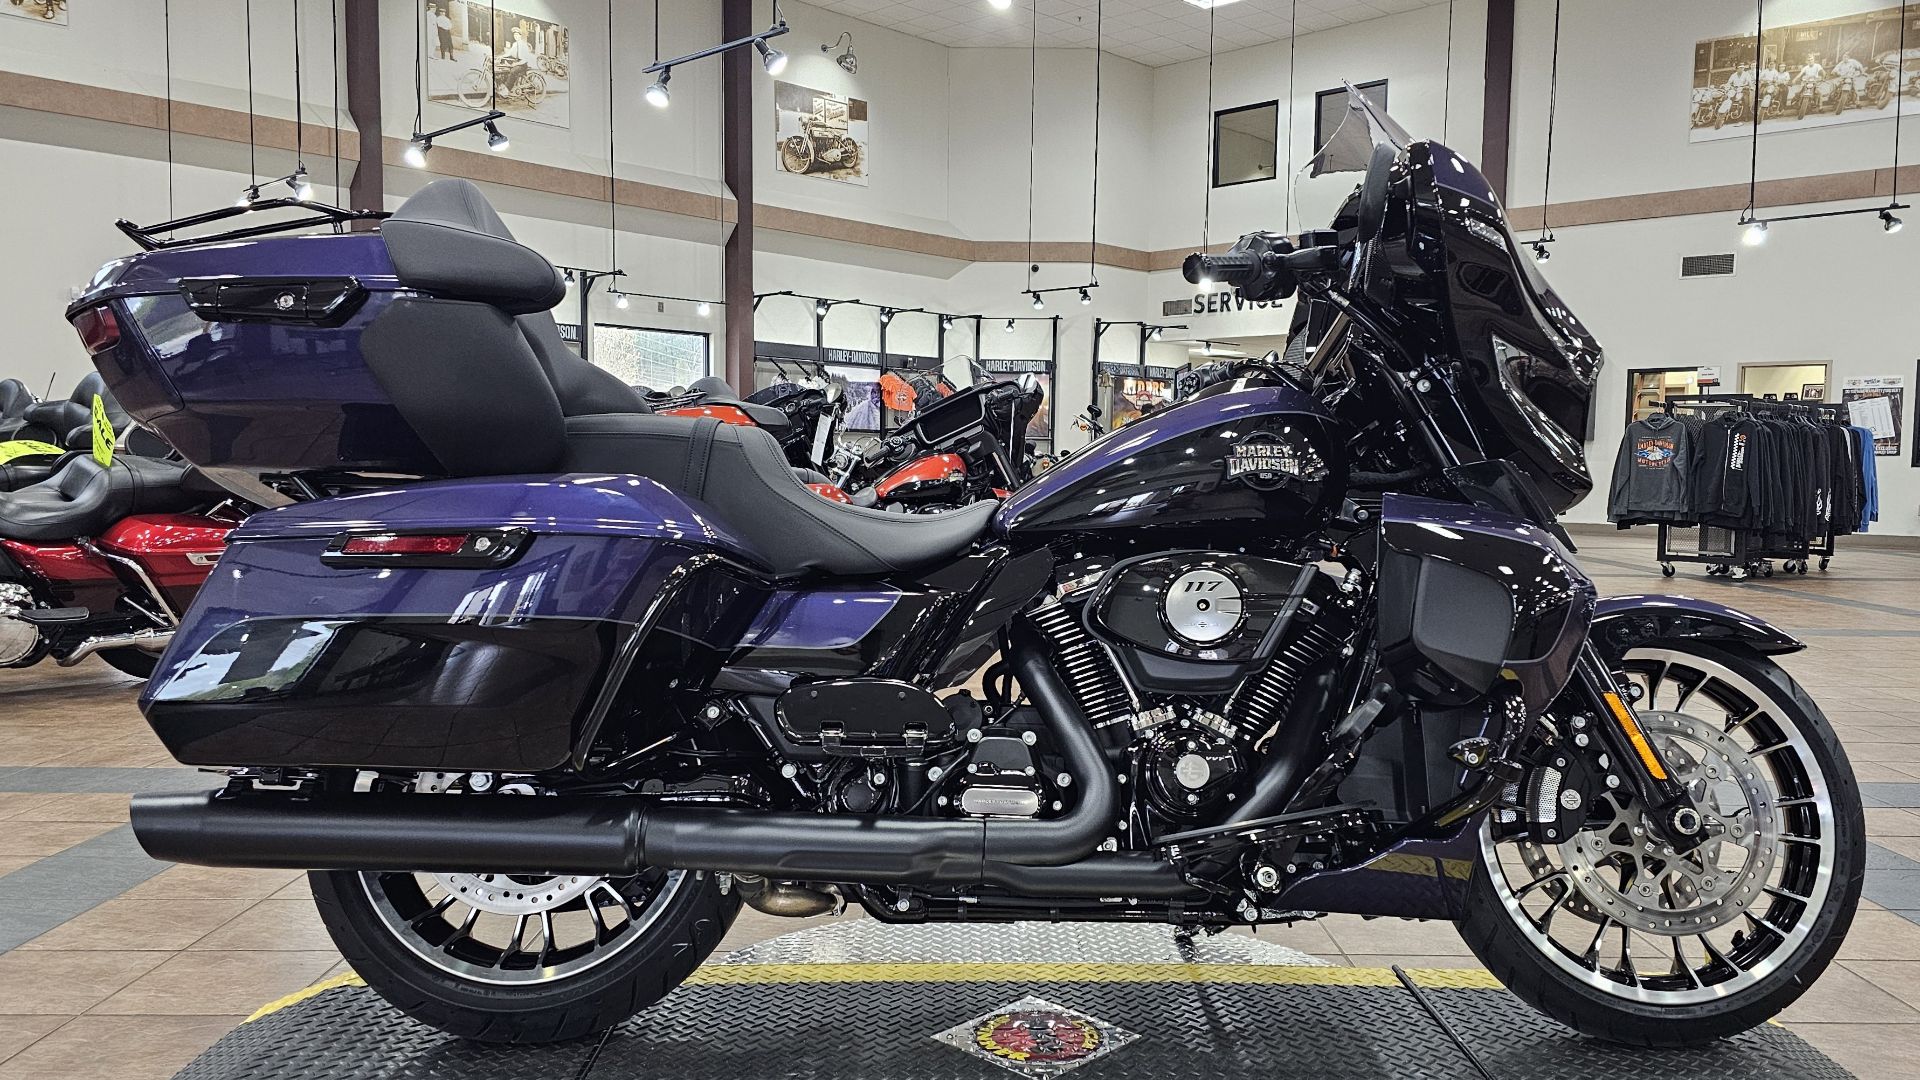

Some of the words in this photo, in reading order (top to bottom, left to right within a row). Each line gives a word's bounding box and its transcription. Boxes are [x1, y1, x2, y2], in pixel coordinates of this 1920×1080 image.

[828, 349, 879, 365] HARLEY-DAVIDSON
[985, 360, 1046, 372] HARLEY-DAVIDSON
[1229, 458, 1299, 476] DAVIDSON
[1184, 581, 1224, 593] 117
